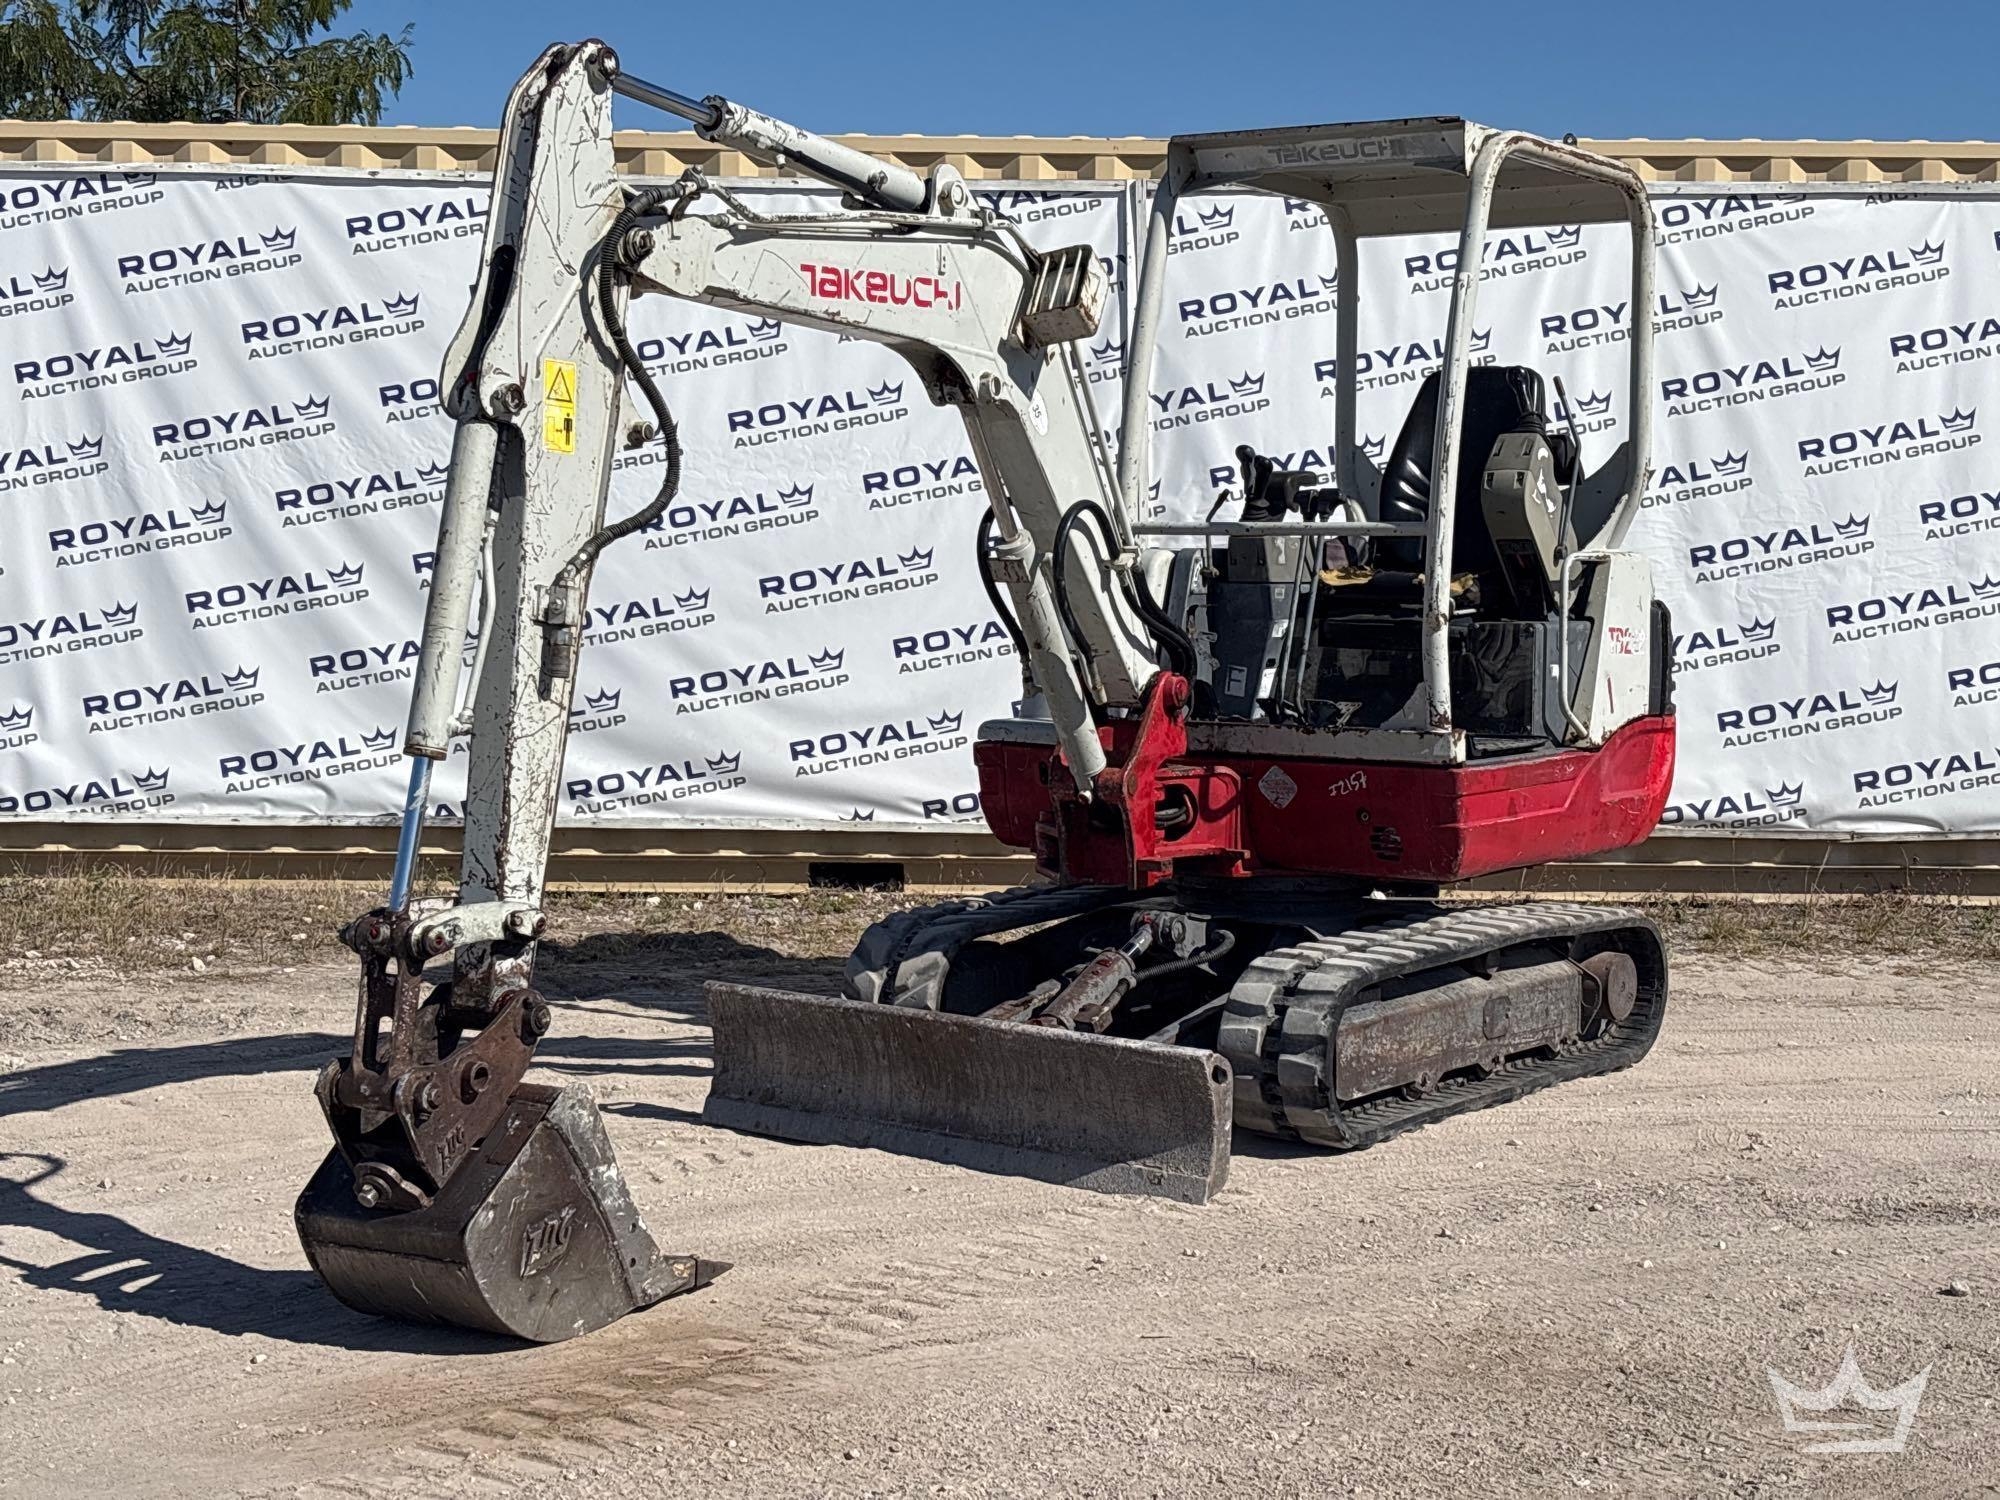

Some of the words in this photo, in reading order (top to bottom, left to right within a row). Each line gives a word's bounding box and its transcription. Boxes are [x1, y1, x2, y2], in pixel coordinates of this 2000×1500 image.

[0, 174, 122, 212] OYAL
[1, 205, 82, 229] UCTION
[88, 191, 163, 213] GROUP
[980, 190, 1060, 212] YAL
[1027, 199, 1101, 222] GROUP
[1661, 193, 1773, 227] OYAL
[346, 198, 488, 238] ROYAL
[1656, 222, 1733, 246] UCTION
[1739, 207, 1814, 229] GROUP
[118, 237, 260, 278] ROYAL
[353, 229, 449, 255] AUCTION
[1167, 232, 1239, 255] GROUP
[125, 268, 221, 294] AUCTION
[226, 254, 301, 276] GROUP
[1512, 250, 1587, 274] GROUP
[1768, 252, 1910, 293] ROYAL
[0, 294, 73, 317] GROUP
[1179, 279, 1319, 322] ROYAL
[1775, 283, 1870, 310] AUCTION
[1876, 268, 1949, 290] GROUP
[242, 303, 383, 343] ROYAL
[1186, 311, 1280, 338] AUCTION
[1541, 295, 1682, 337] ROYL
[249, 334, 344, 360] AUCTION
[349, 320, 424, 342] GROUP
[637, 326, 747, 361] OYAL
[713, 343, 787, 366] GROUP
[1890, 318, 2000, 357] ROYA
[14, 343, 156, 383] ROYAL
[1897, 346, 1991, 373] AUCTION
[22, 374, 116, 400] AUCTION
[123, 360, 197, 382] GROUP
[1150, 383, 1229, 413] YAL
[1662, 358, 1804, 401] ROYAL
[1669, 390, 1764, 416] AUCTION
[1770, 374, 1845, 397] GROUP
[153, 406, 294, 446] ROYAL
[728, 392, 868, 432] ROYAL
[735, 423, 828, 448] AUCTION
[834, 408, 908, 430] GROUP
[1195, 399, 1269, 422] GROUP
[160, 437, 254, 462] AUCTION
[260, 423, 335, 444] GROUP
[1798, 419, 1939, 461] ROYAL
[1805, 450, 1900, 477] AUCTION
[1906, 435, 1981, 457] GROUP
[33, 462, 108, 484] GROUP
[613, 451, 668, 470] GROU
[862, 456, 979, 494] ROYA
[276, 471, 417, 511] ROYAL
[283, 502, 377, 527] AUCTION
[383, 490, 445, 510] GROU
[870, 483, 962, 510] AUCTION
[1676, 478, 1753, 501] GROUP
[1919, 490, 2000, 524] ROY
[49, 511, 190, 551] ROYAL
[56, 541, 151, 567] AUCTION
[156, 527, 232, 549] GROUP
[645, 524, 739, 550] AUCTION
[744, 510, 818, 532] GROUP
[1690, 525, 1833, 567] ROYAL
[759, 557, 898, 598] ROYAL
[1697, 556, 1792, 583] AUCTION
[1798, 541, 1874, 564] GROUP
[186, 573, 327, 613] ROYAL
[193, 603, 289, 629] AUCTION
[294, 590, 368, 611] GROUP
[766, 588, 859, 614] AUCTION
[865, 574, 938, 595] GROUP
[1826, 585, 1971, 627] ROYAL
[0, 612, 102, 648] OYAL
[641, 614, 714, 636] GROUP
[893, 621, 1008, 658] ROYA
[1834, 617, 1929, 643] AUCTION
[1935, 603, 2000, 624] GROU
[0, 644, 62, 664] CTION
[68, 629, 143, 651] GROUP
[310, 640, 421, 677] ROYA
[899, 647, 992, 674] AUCTION
[1703, 644, 1780, 667] GROUP
[83, 677, 224, 717] ROYAL
[317, 667, 411, 693] AUCTION
[670, 658, 809, 699] ROYAL
[677, 689, 770, 715] AUCTION
[775, 675, 849, 696] GROUP
[90, 707, 185, 733] AUCTION
[191, 693, 264, 715] GROUP
[569, 714, 626, 733] ROUP
[1718, 691, 1861, 732] ROYAL
[1725, 722, 1820, 746] AUCTION
[1826, 707, 1902, 729] GROUP
[220, 738, 361, 778] ROYAL
[790, 722, 928, 762] ROYAL
[797, 751, 889, 777] AUCTION
[894, 737, 967, 758] GROUP
[226, 769, 322, 794] AUCTION
[326, 752, 404, 776] GROUP
[567, 761, 706, 800] ROYAL
[1854, 751, 1996, 792] ROYAL
[575, 791, 667, 818] AUCTION
[673, 777, 746, 798] GROUP
[1659, 792, 1766, 825] OYAL
[1859, 782, 1954, 809] AUCTION
[1731, 808, 1807, 830] GROUP
